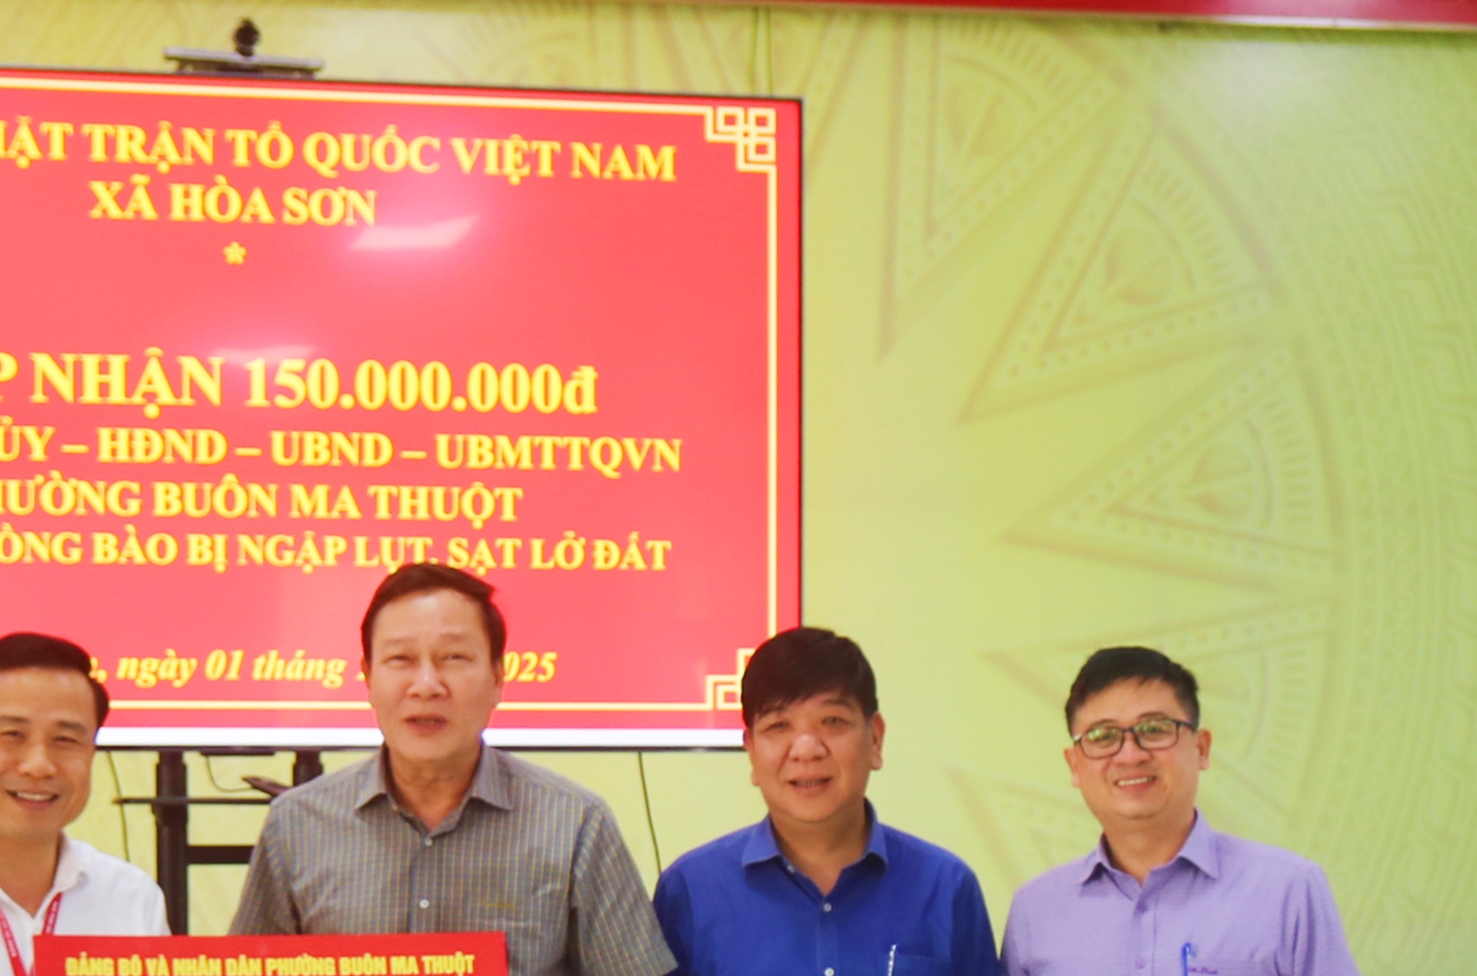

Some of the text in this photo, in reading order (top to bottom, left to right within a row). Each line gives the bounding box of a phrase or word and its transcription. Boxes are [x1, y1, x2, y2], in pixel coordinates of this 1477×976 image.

[81, 121, 214, 173] TRẬN
[225, 121, 293, 168] TỔ
[303, 125, 441, 178] QUỐC
[450, 134, 561, 185] VIỆT
[572, 142, 675, 181] NAM
[90, 174, 381, 230] XÃ HÒA SƠN
[32, 347, 225, 418] NHẬN
[244, 356, 597, 413] 150.000.000đ
[98, 428, 227, 464] HĐND
[271, 431, 393, 466] UBND
[436, 434, 681, 478] UBMTTQVN
[153, 473, 278, 518] BUÔN
[290, 484, 362, 519] MA
[368, 482, 523, 529] THUỘT
[92, 524, 178, 565] BÀO
[187, 534, 227, 573] BỊ
[237, 530, 347, 574] NGẬP
[447, 537, 522, 576] SẠT
[530, 531, 586, 570] LỞ
[593, 532, 672, 570] ĐẤT
[116, 649, 197, 688] ngày
[205, 649, 243, 680] 01
[252, 649, 347, 689] tháng
[504, 652, 557, 682] 025
[65, 952, 115, 976] ĐẢNG
[145, 954, 170, 976] VÀ
[225, 954, 262, 976] DÂN
[265, 953, 336, 976] PHƯỜNG
[339, 953, 387, 976] BUÔN
[390, 956, 419, 975] MA
